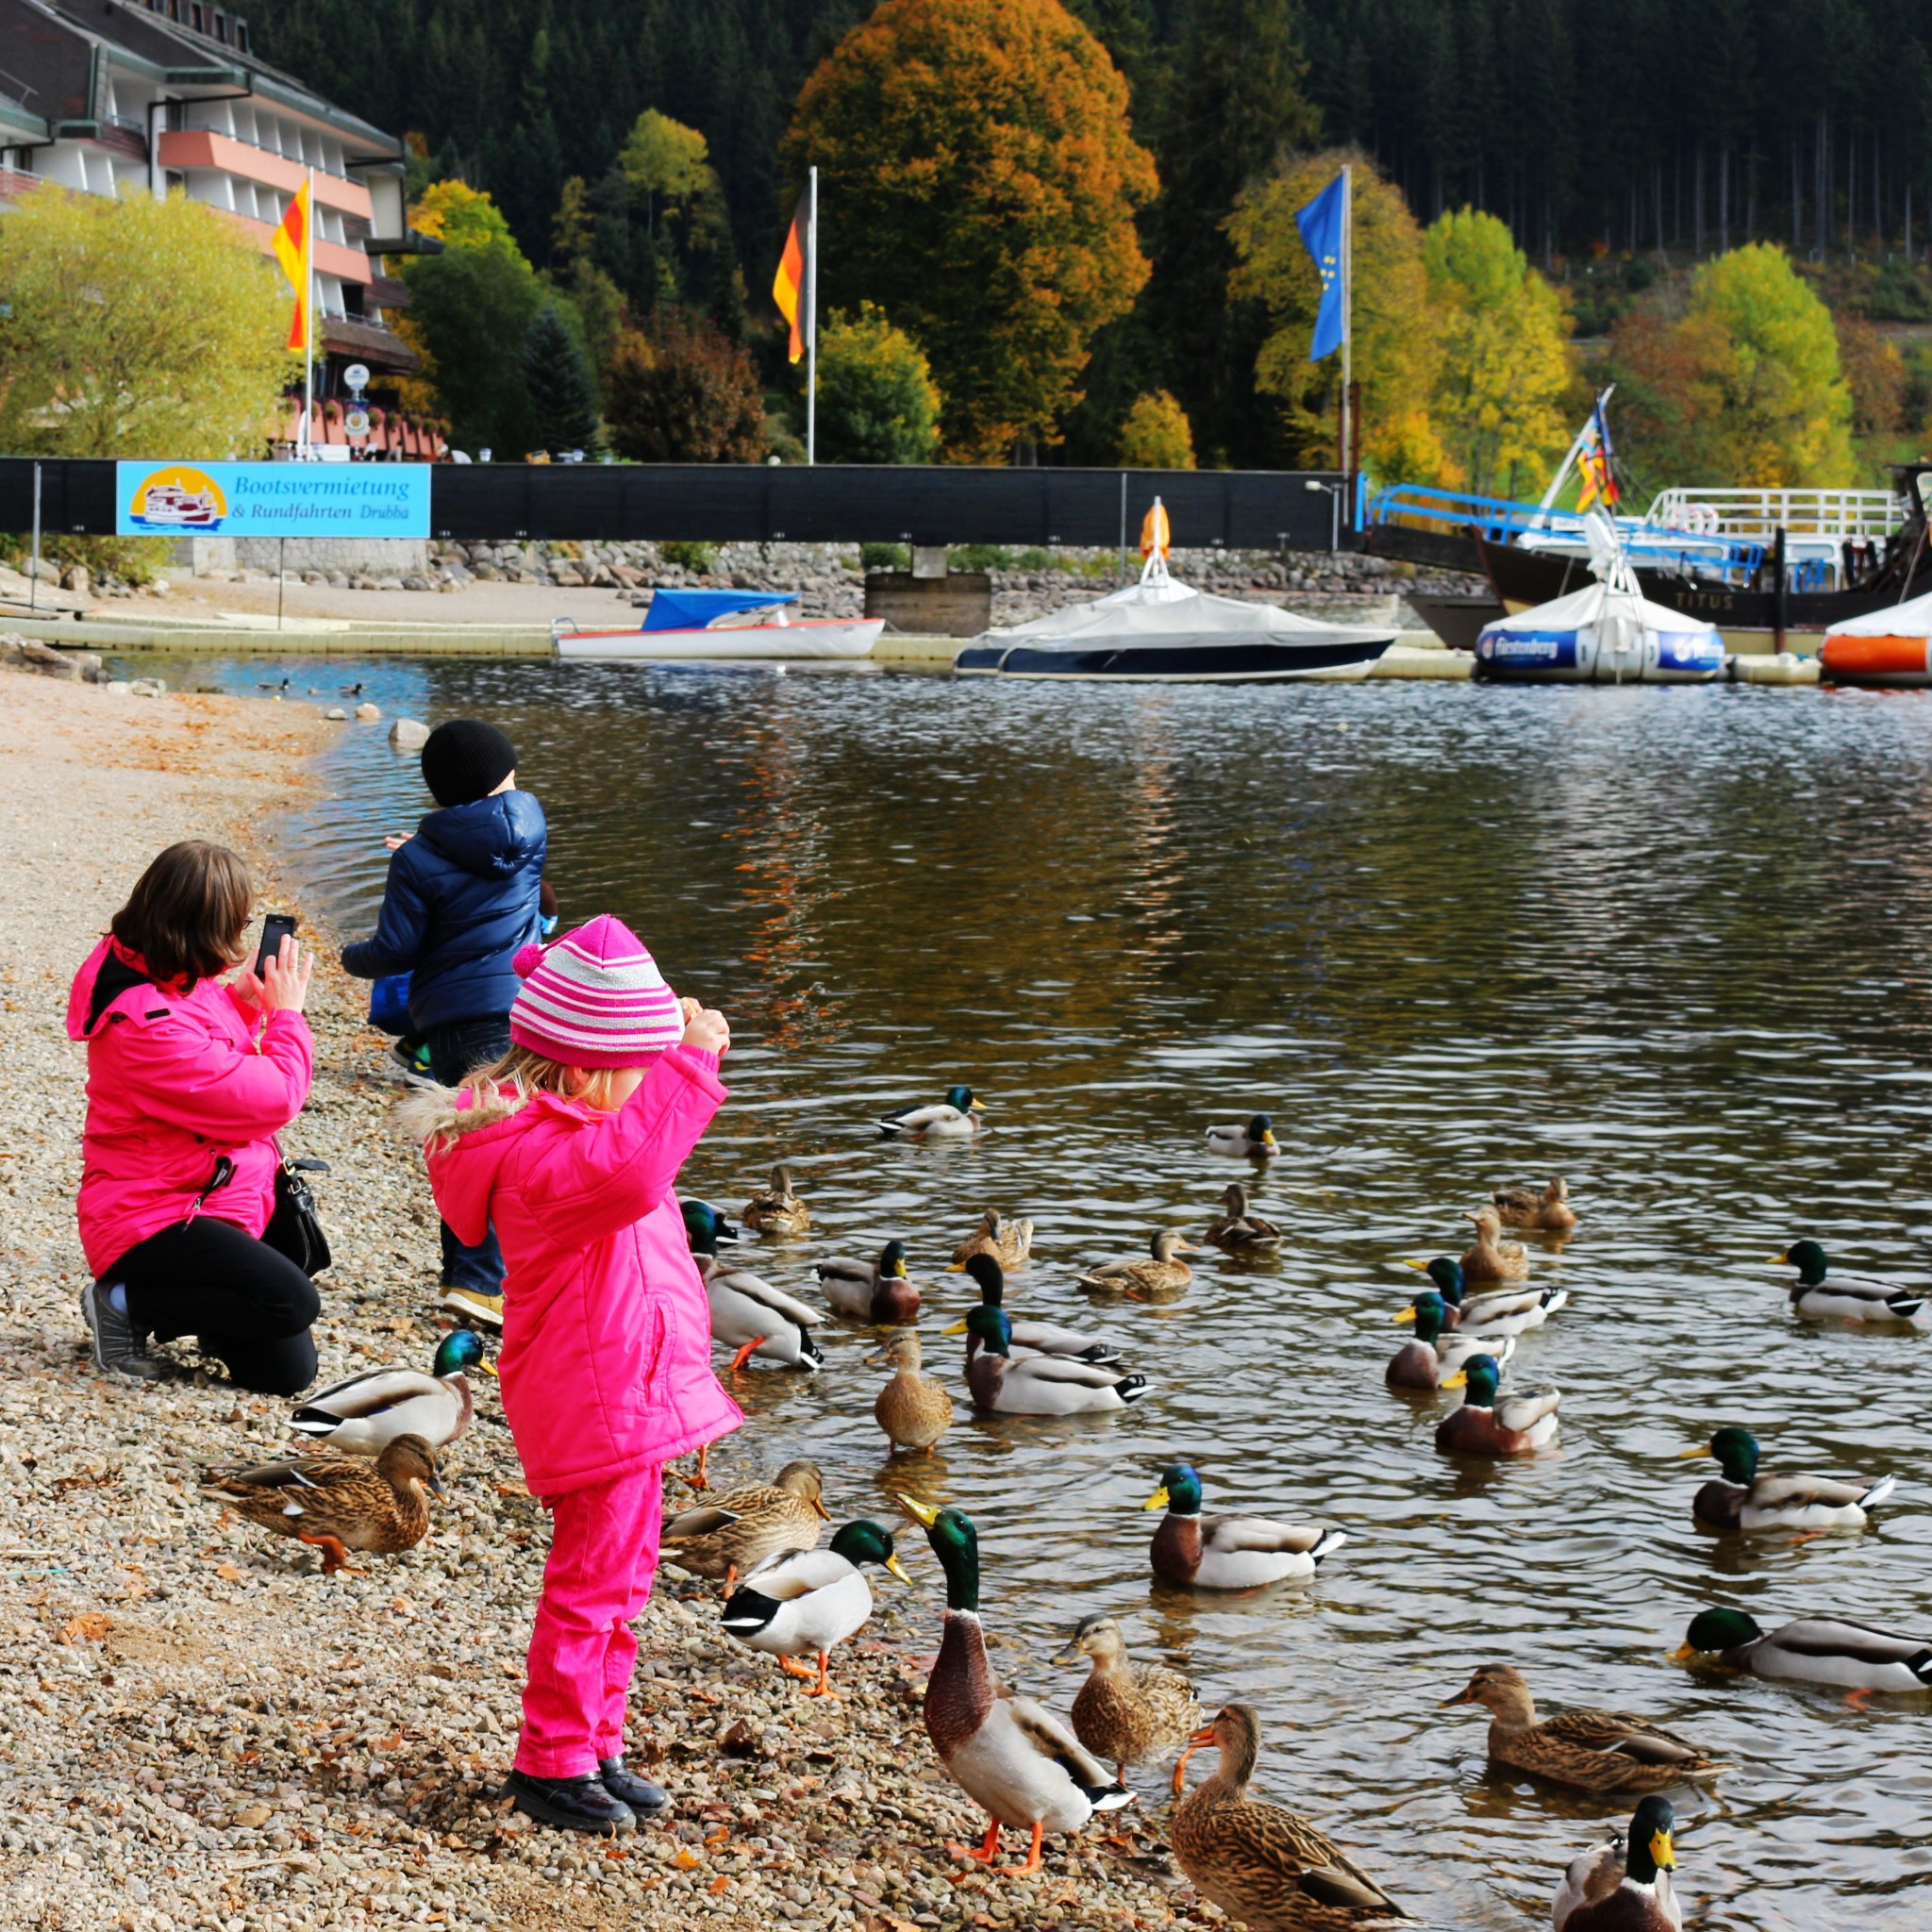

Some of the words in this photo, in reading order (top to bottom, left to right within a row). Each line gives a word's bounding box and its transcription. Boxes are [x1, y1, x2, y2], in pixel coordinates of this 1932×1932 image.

[234, 476, 410, 502] Bootsvermietung
[231, 504, 245, 518] &
[251, 503, 353, 523] Rundfahrten
[360, 504, 409, 519] Drubba
[1675, 591, 1734, 610] TITUS
